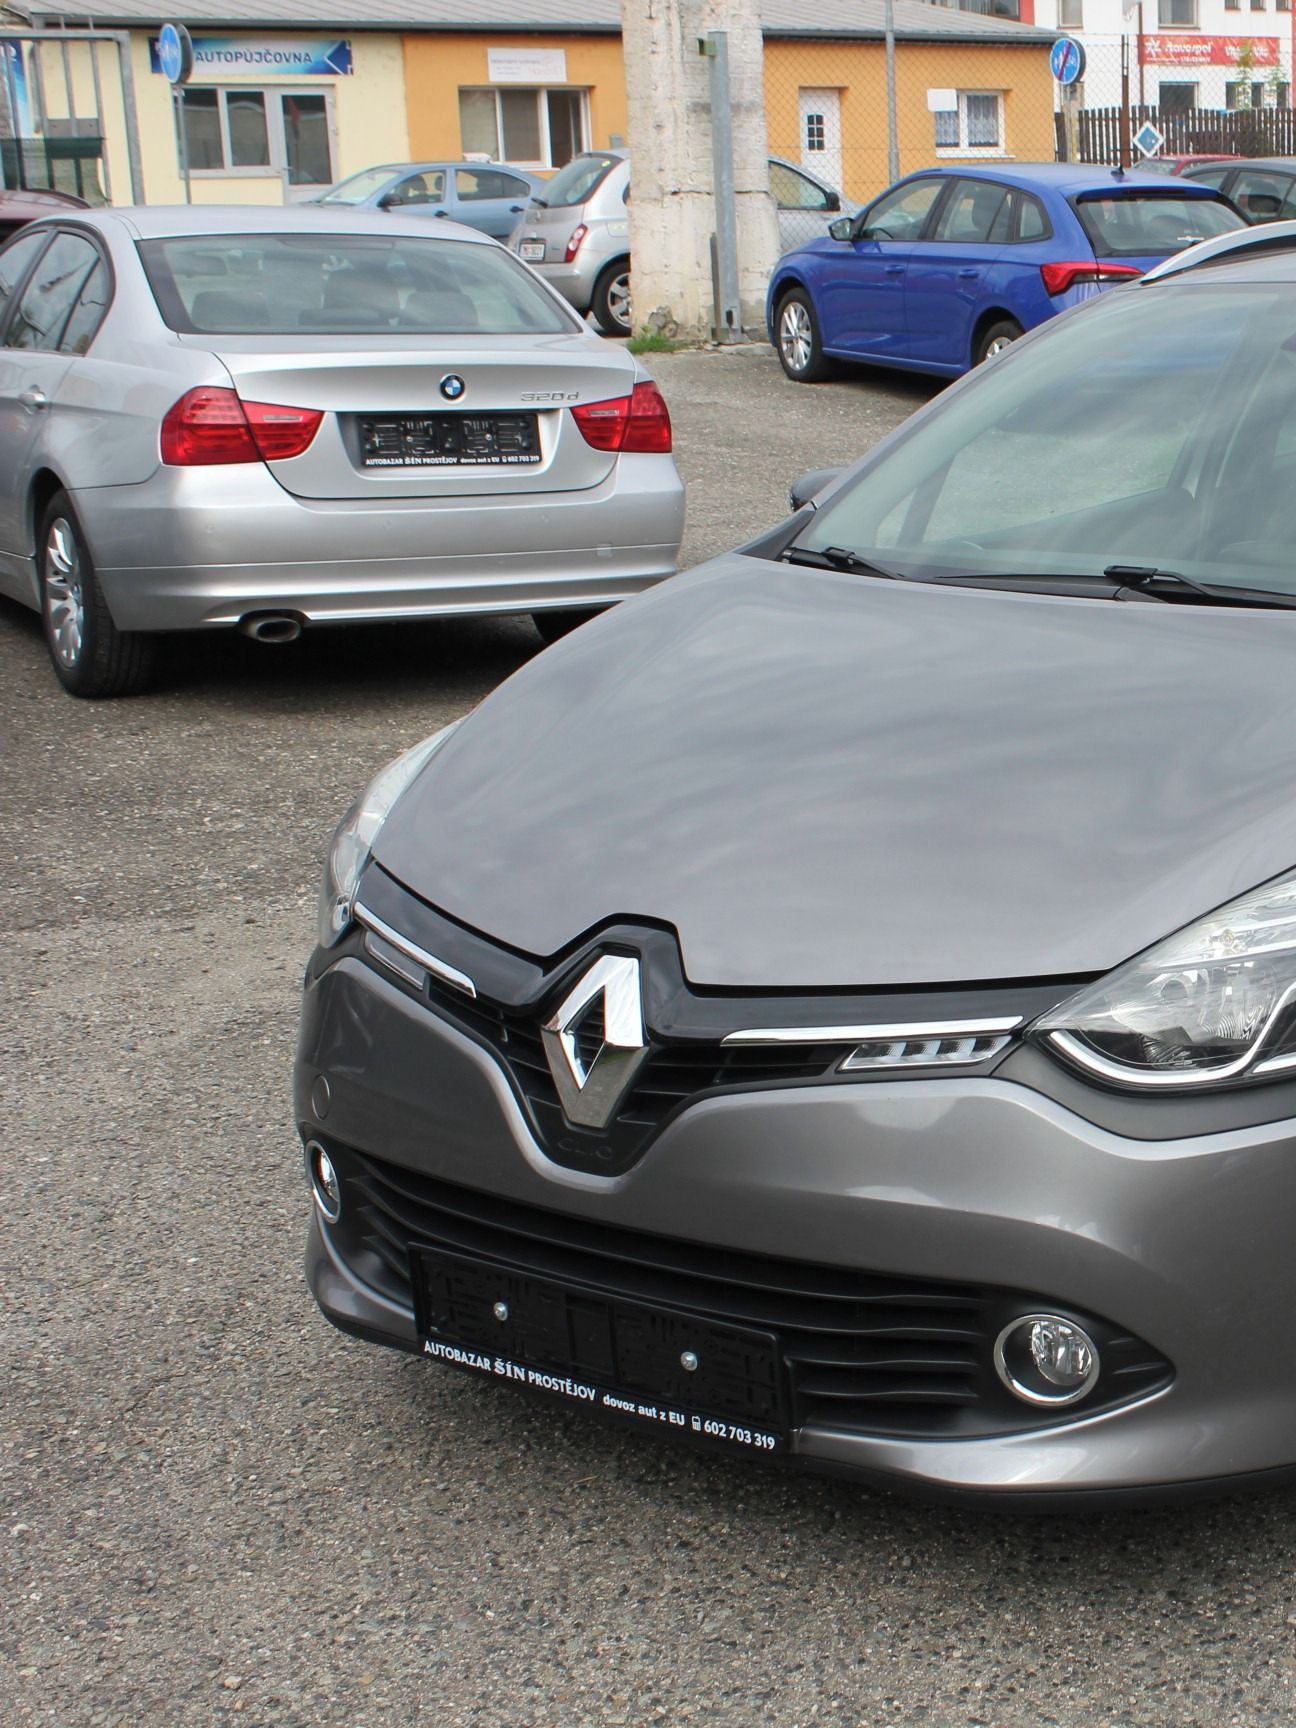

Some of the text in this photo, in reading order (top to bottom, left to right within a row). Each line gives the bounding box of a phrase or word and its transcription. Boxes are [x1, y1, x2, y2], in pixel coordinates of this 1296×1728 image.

[195, 48, 313, 64] AUTOPŮJČOVNA
[424, 1340, 776, 1450] AUTOBAZAR ŠÍN PROSTĚJOV dovoz aut z EU 602 703 319
